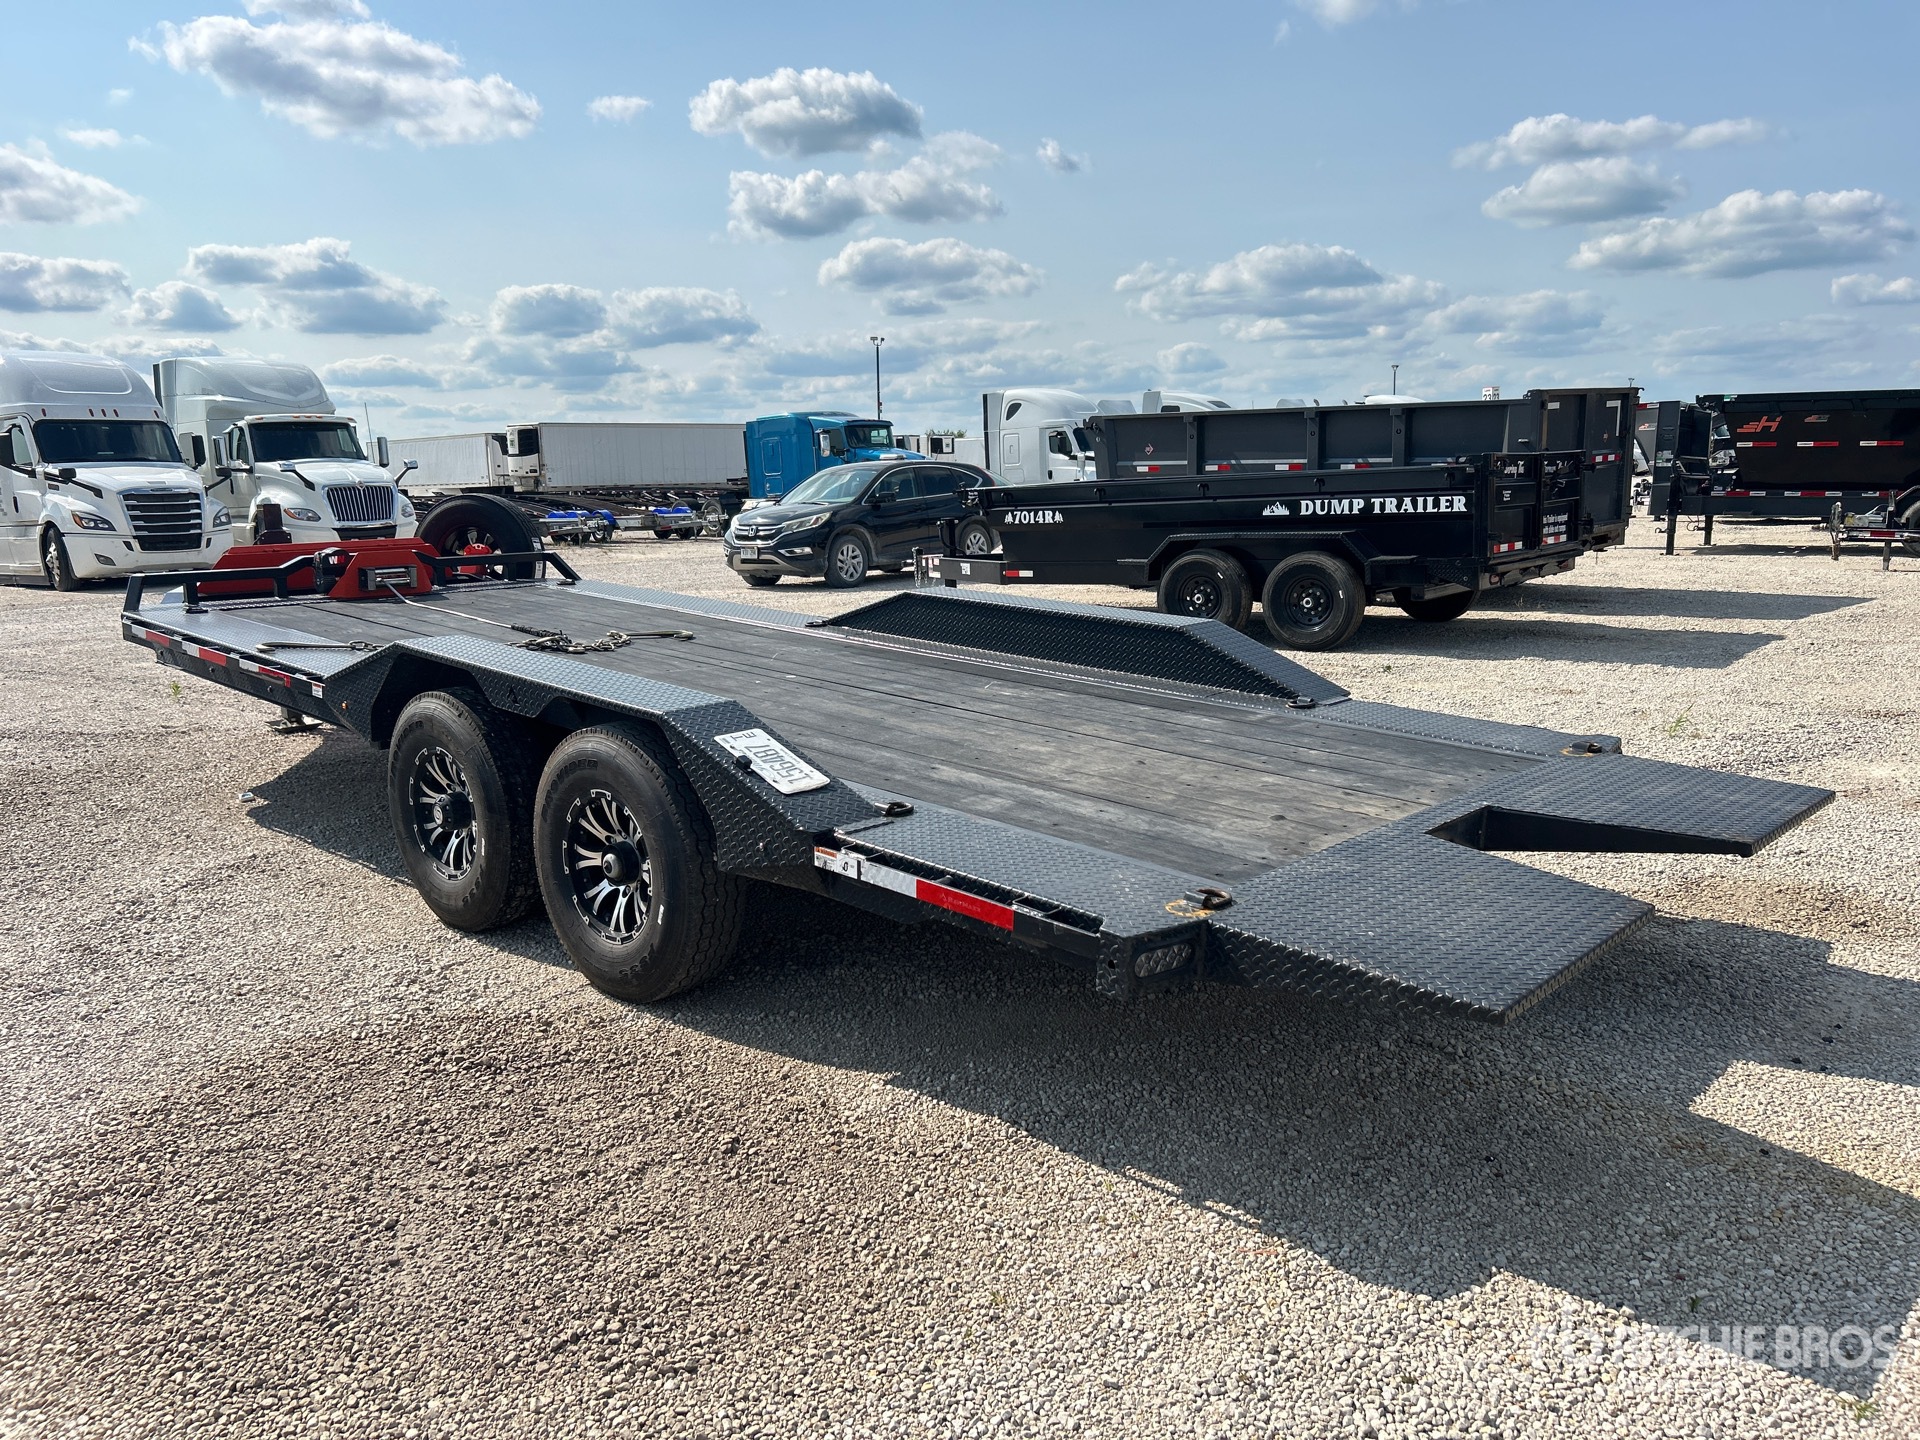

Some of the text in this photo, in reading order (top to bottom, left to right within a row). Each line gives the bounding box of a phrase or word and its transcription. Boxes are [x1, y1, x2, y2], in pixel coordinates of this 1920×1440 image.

[1299, 495, 1468, 516] DUMP TRAILER
[1013, 510, 1054, 525] 7014R
[743, 744, 814, 784] 156487
